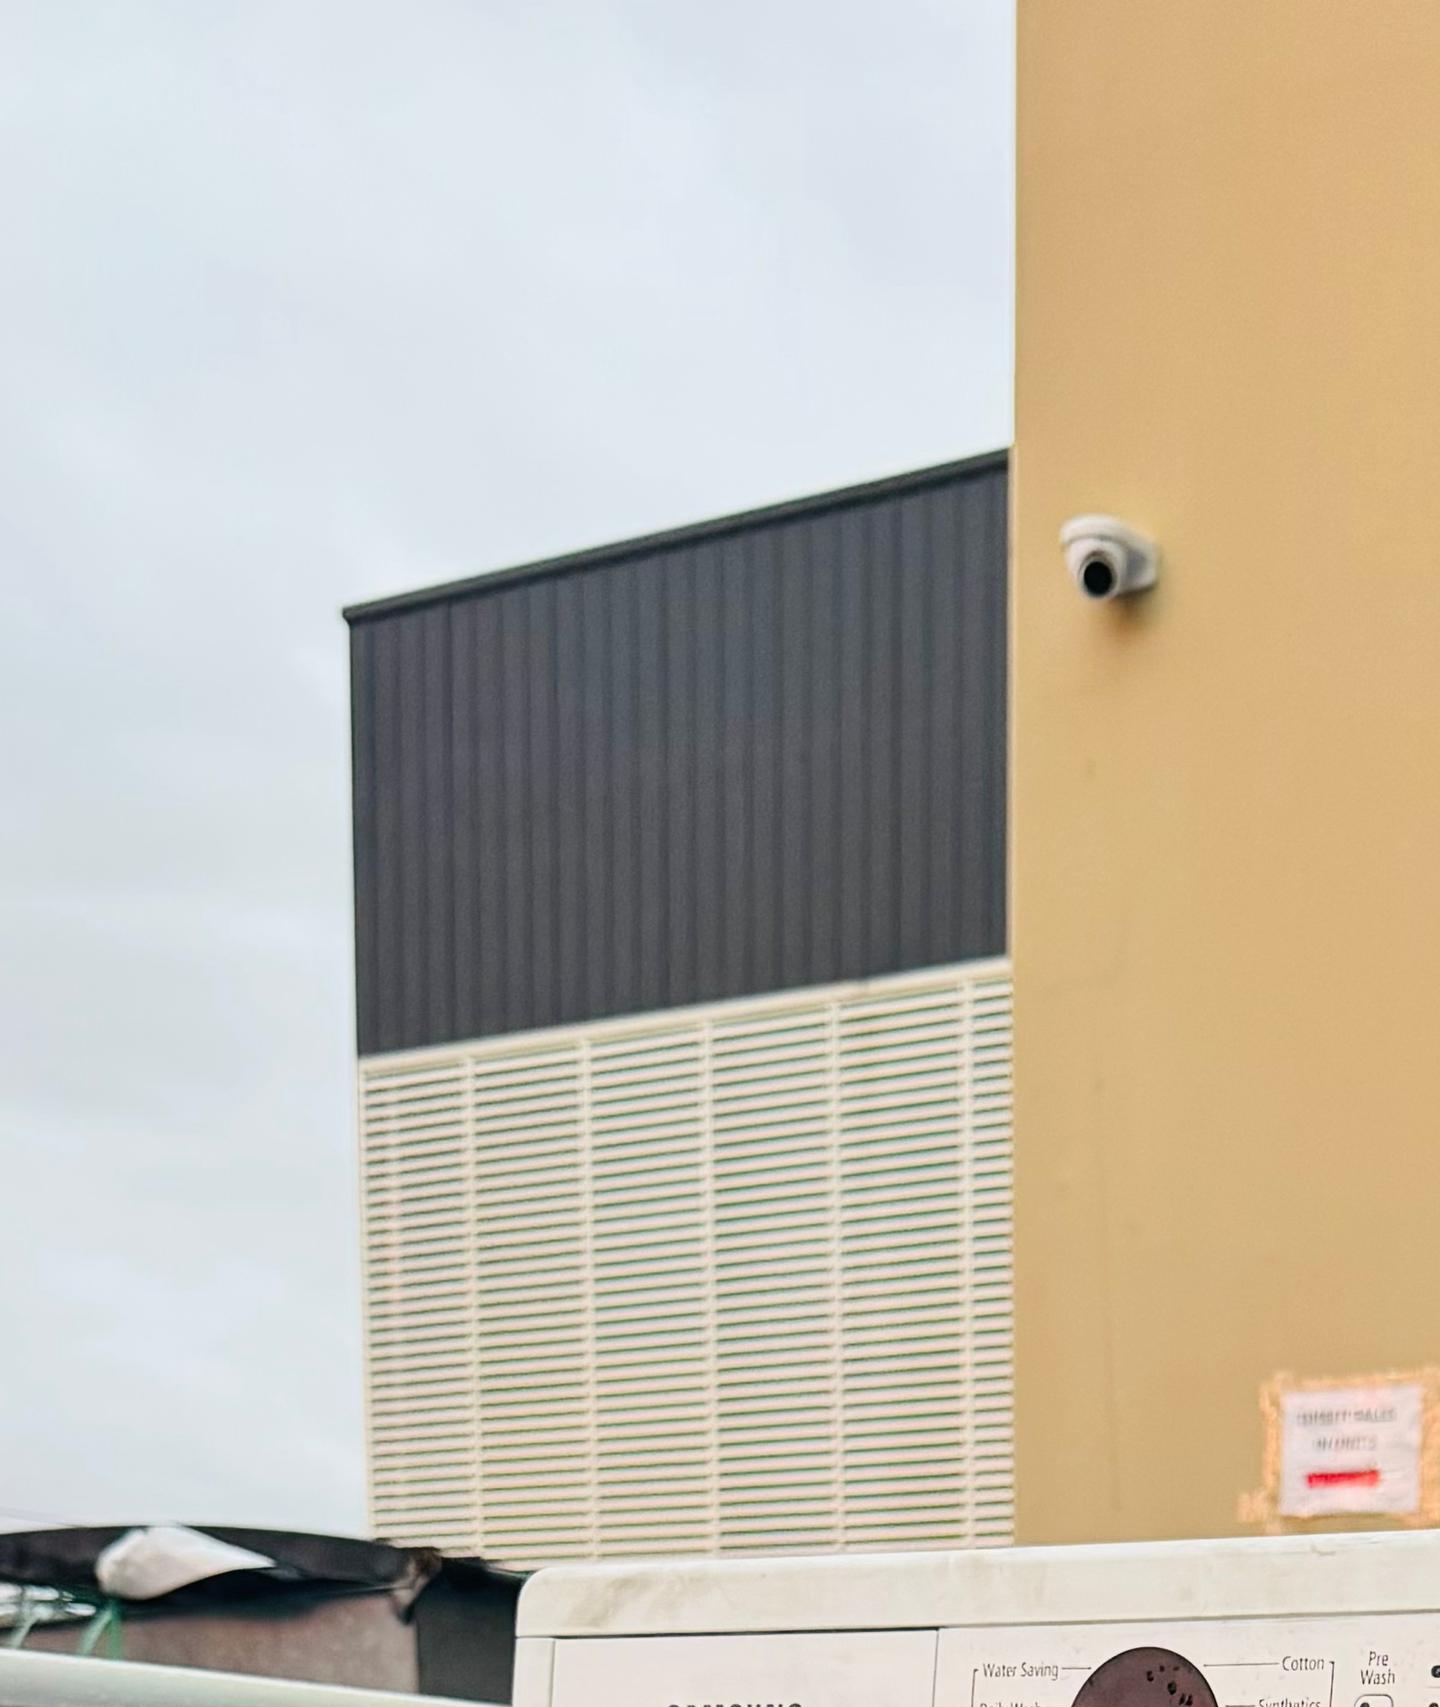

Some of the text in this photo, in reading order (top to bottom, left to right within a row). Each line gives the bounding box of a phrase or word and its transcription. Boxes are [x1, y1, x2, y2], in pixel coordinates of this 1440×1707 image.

[1281, 1655, 1325, 1671] Cotton
[1368, 1651, 1389, 1667] Pre
[982, 1661, 1059, 1680] Water Saving
[1360, 1669, 1396, 1685] Wash
